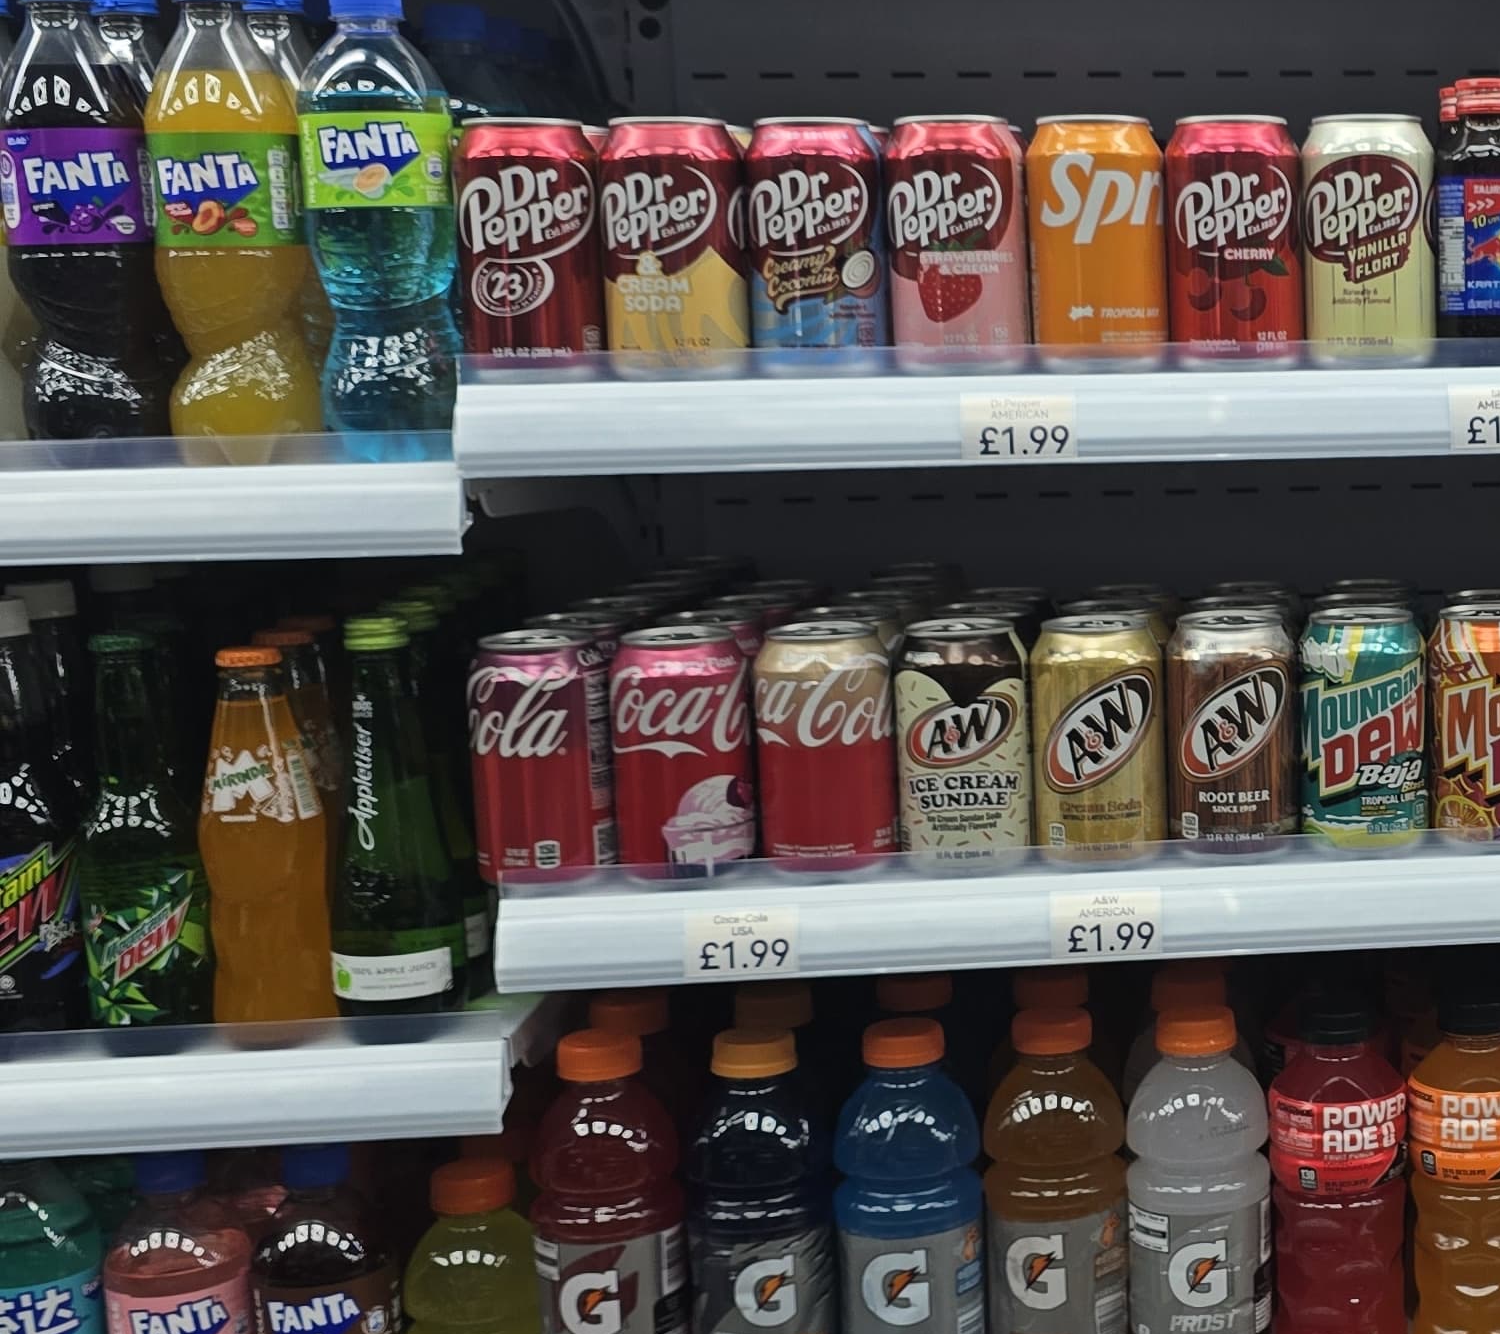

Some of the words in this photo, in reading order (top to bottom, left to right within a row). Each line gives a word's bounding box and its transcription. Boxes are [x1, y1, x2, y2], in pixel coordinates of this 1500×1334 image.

[317, 120, 420, 163] FANTA
[21, 150, 130, 195] FANTA
[157, 154, 257, 196] FANTA
[497, 165, 558, 208] Dr
[623, 172, 673, 205] Dr
[779, 170, 830, 203] Dr
[915, 171, 961, 205] Dr
[1209, 171, 1260, 204] Dr
[463, 175, 589, 254] Pepper
[604, 182, 705, 252] Pepper
[749, 179, 861, 246] Pepper
[889, 180, 993, 249] Pepper
[1224, 248, 1275, 262] CHERRY
[1346, 230, 1408, 261] VANILLA
[1355, 251, 1402, 279] FLOAT
[489, 272, 523, 302] 23
[617, 275, 689, 294] CREAM
[624, 295, 683, 313] SODA
[991, 409, 1049, 421] AMERICAN
[979, 425, 1070, 456] £1.99
[926, 700, 996, 758] A&W
[347, 724, 380, 852] Appletiser
[909, 778, 942, 795] ICE
[944, 774, 1019, 791] CREAM
[1358, 758, 1422, 788] Baja
[920, 790, 1010, 809] SUNDAE
[1198, 790, 1236, 803] ROOT
[1239, 790, 1271, 802] BEER
[1079, 906, 1136, 919] AMERICAN
[731, 926, 755, 937] USA
[1068, 921, 1155, 953] £1.99
[699, 938, 790, 971] £1.99
[268, 1293, 360, 1334] FANTA
